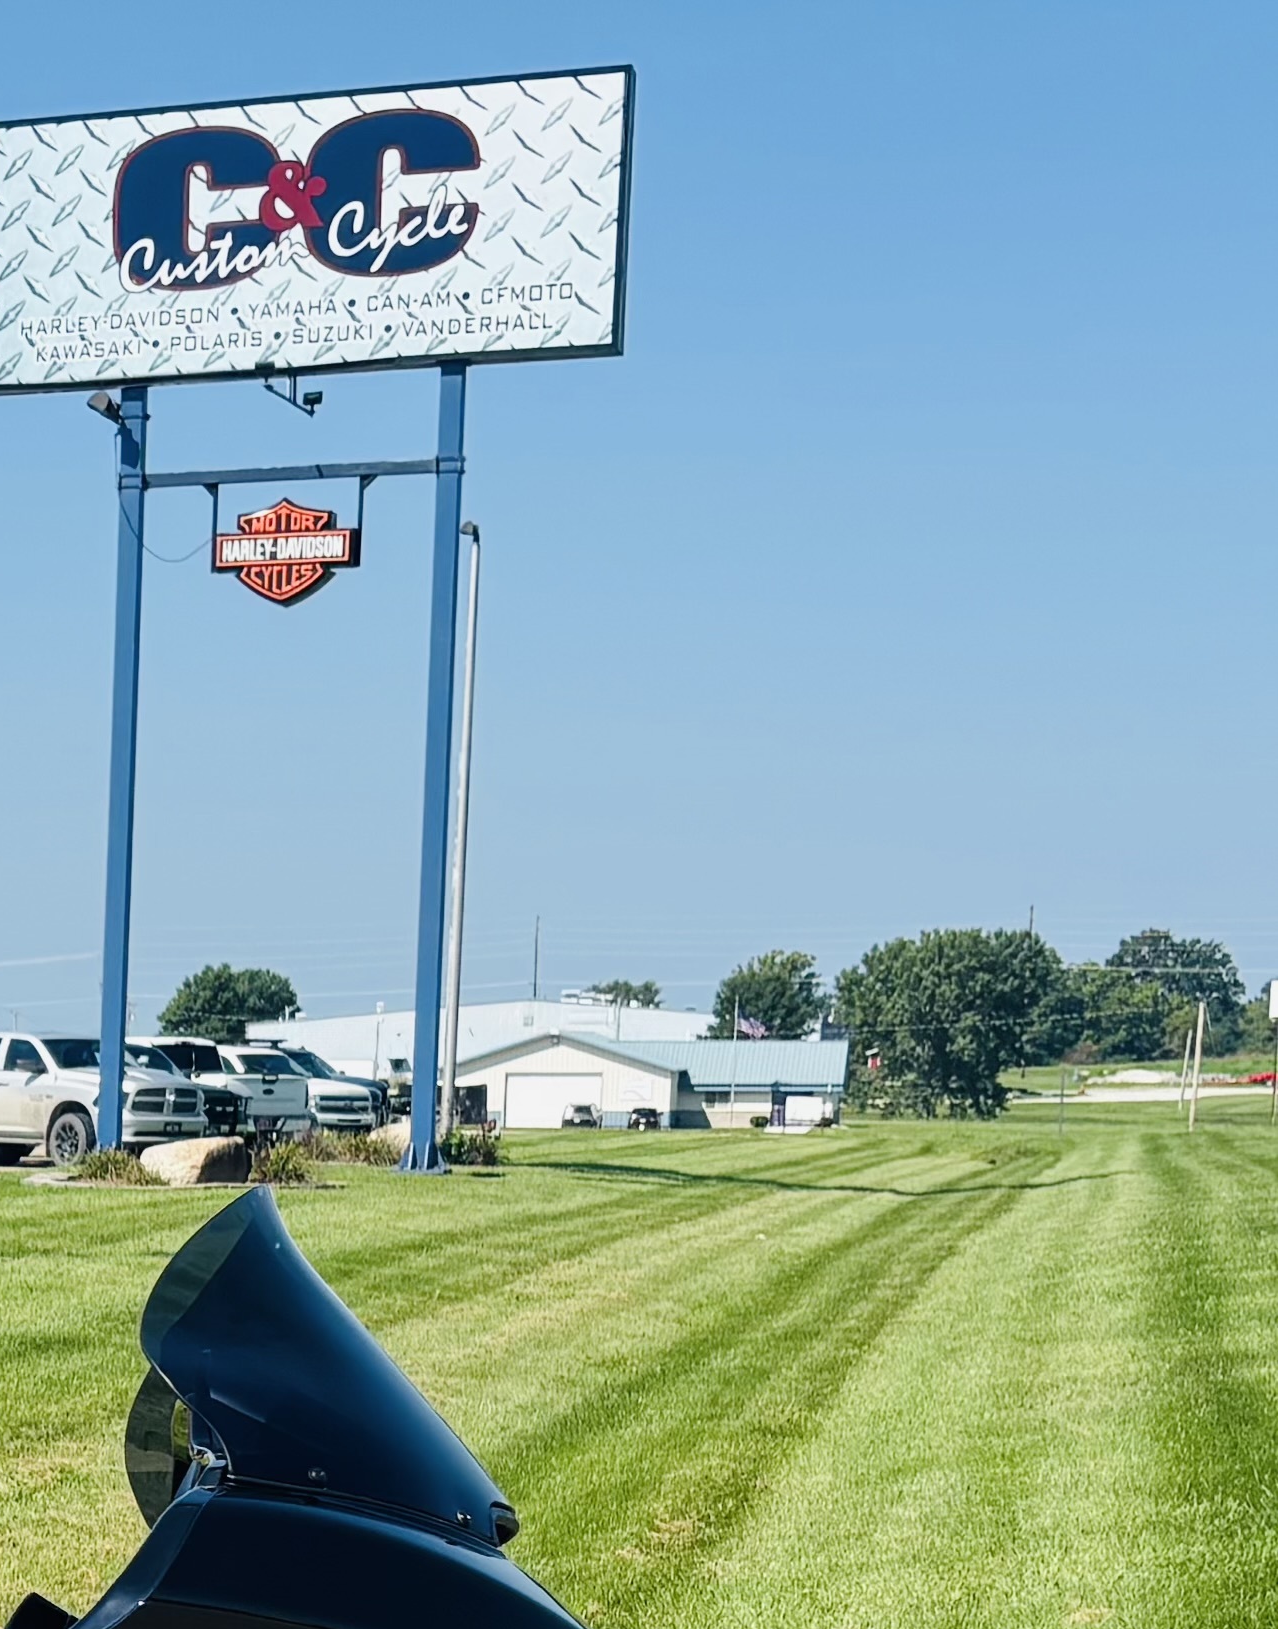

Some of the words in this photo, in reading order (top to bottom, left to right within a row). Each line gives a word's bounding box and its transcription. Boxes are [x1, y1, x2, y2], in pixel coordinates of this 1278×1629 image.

[113, 109, 480, 291] C&C
[120, 238, 311, 293] Custom
[328, 184, 470, 272] Cycle
[20, 306, 220, 337] HARLEY-DAVIDSON
[248, 298, 337, 320] YAMAHA
[366, 291, 451, 312] CAN-AM
[481, 283, 573, 305] CFMOTO
[36, 339, 142, 363] KAWASAKI
[170, 331, 263, 352] POLARIS
[292, 323, 374, 344] SUZUKI
[401, 312, 554, 337] VANDERHALL
[251, 507, 316, 533] MOTOR
[221, 535, 344, 563] HARLEY-DAVIDSON
[250, 564, 313, 594] CYCLES
